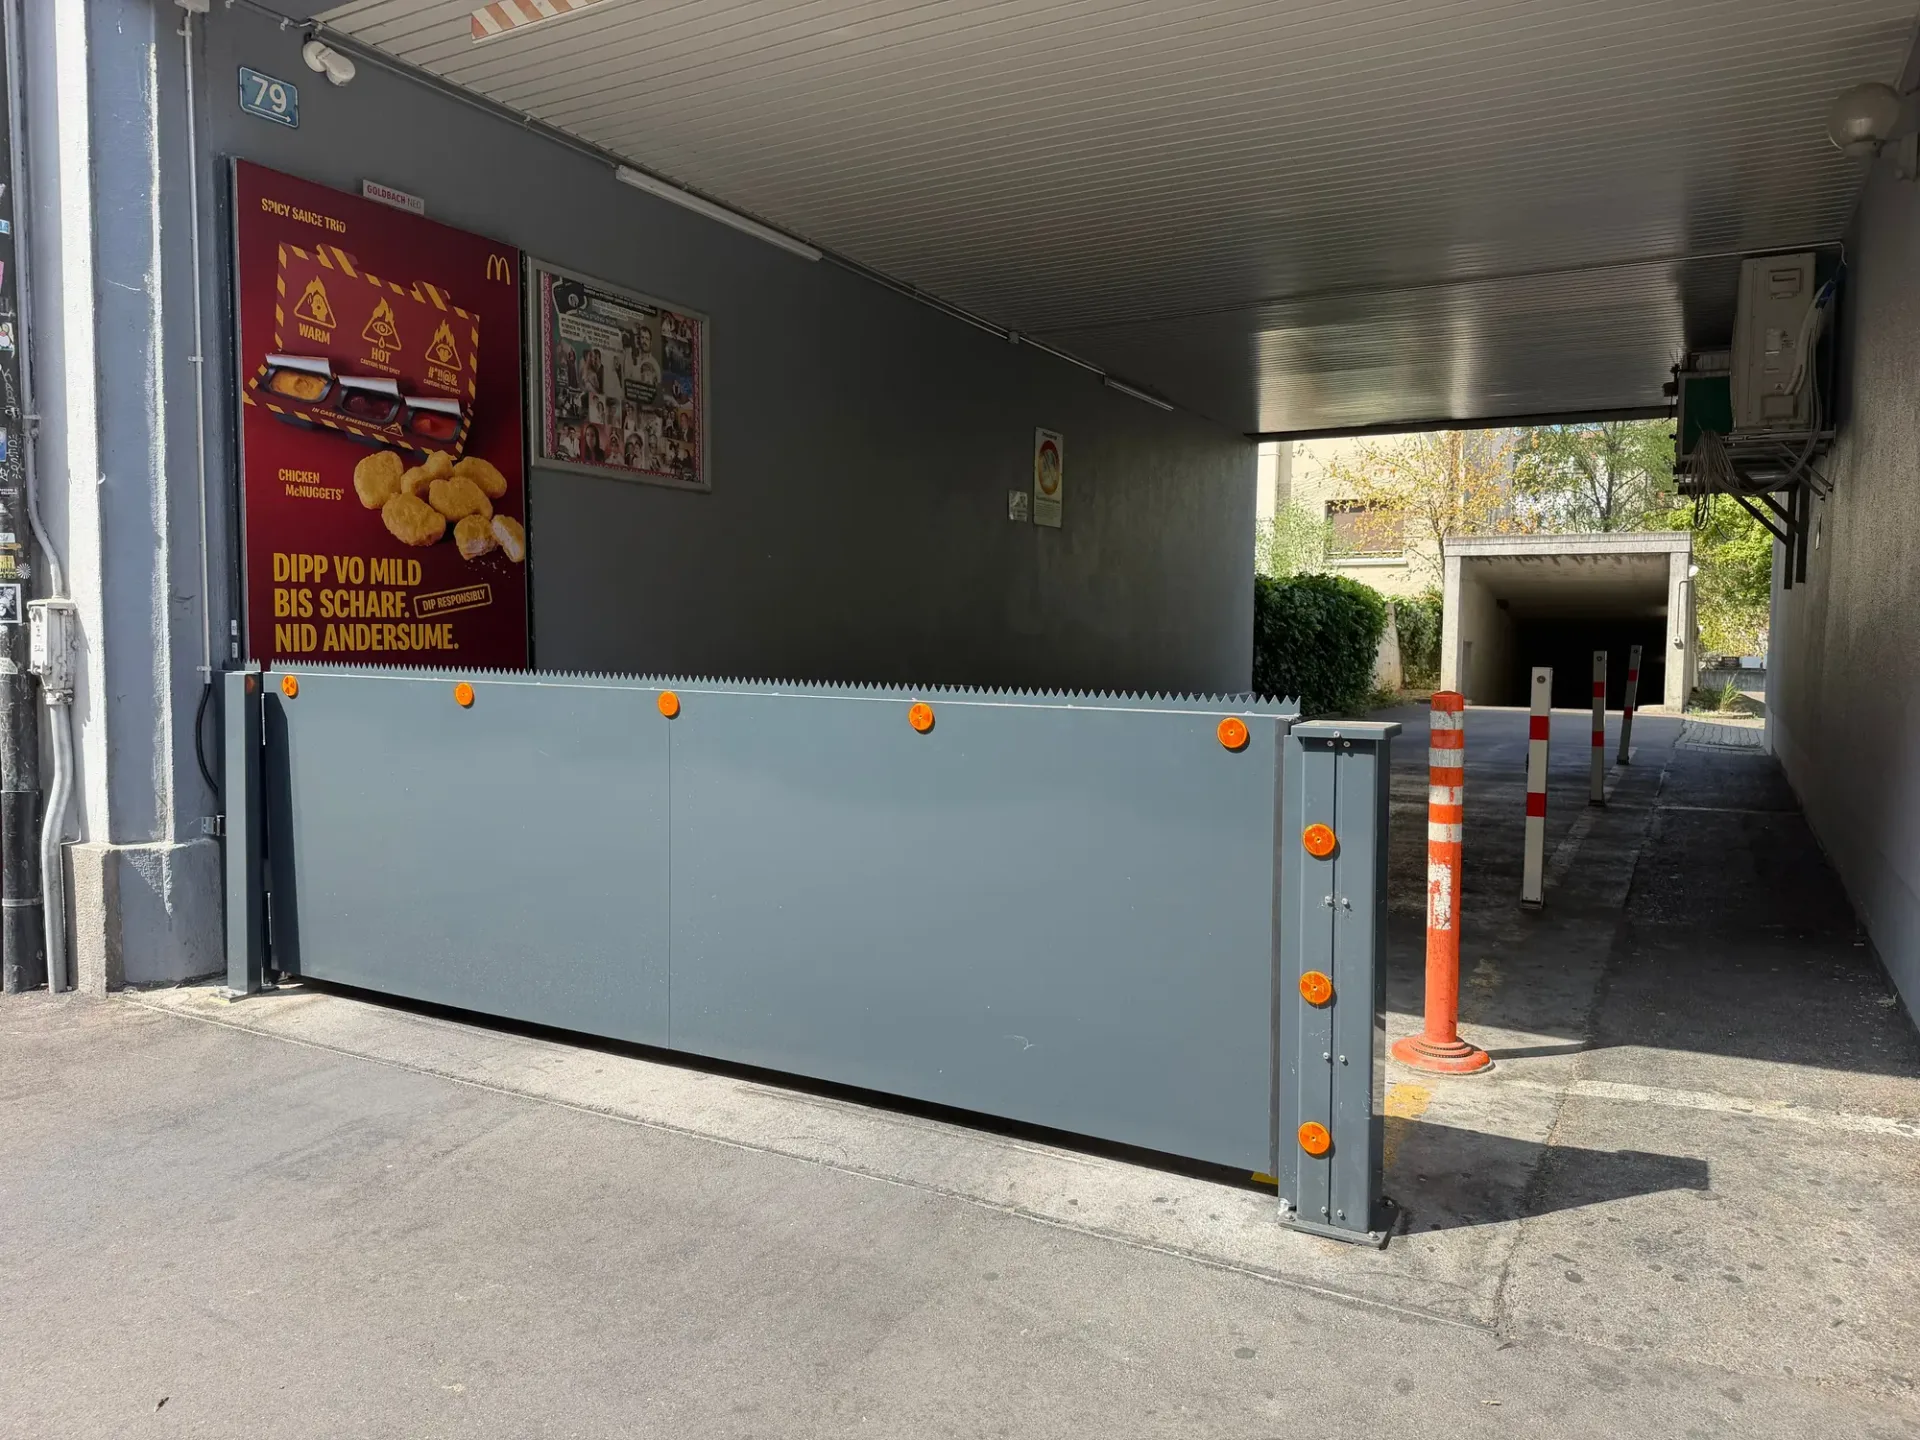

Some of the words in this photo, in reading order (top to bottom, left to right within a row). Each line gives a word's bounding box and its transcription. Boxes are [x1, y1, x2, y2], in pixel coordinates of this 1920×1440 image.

[252, 75, 287, 113] 79
[367, 184, 406, 204] GOLDBACH
[261, 198, 290, 216] SPICY
[292, 207, 323, 227] SAUCE
[325, 216, 346, 233] TRIO
[299, 323, 331, 345] WARM
[371, 347, 391, 364] HOT
[320, 409, 336, 417] CASE
[278, 468, 320, 484] CHICKEN
[273, 552, 328, 583] DIPP
[334, 555, 365, 585] VO
[370, 557, 422, 586] MILD
[274, 588, 313, 618] BIS
[319, 589, 410, 619] SCHARF.
[422, 599, 437, 611] DIP
[437, 589, 486, 608] RESPONSIBLY
[275, 624, 317, 652] NID
[322, 622, 460, 652] ANDERSUME.
